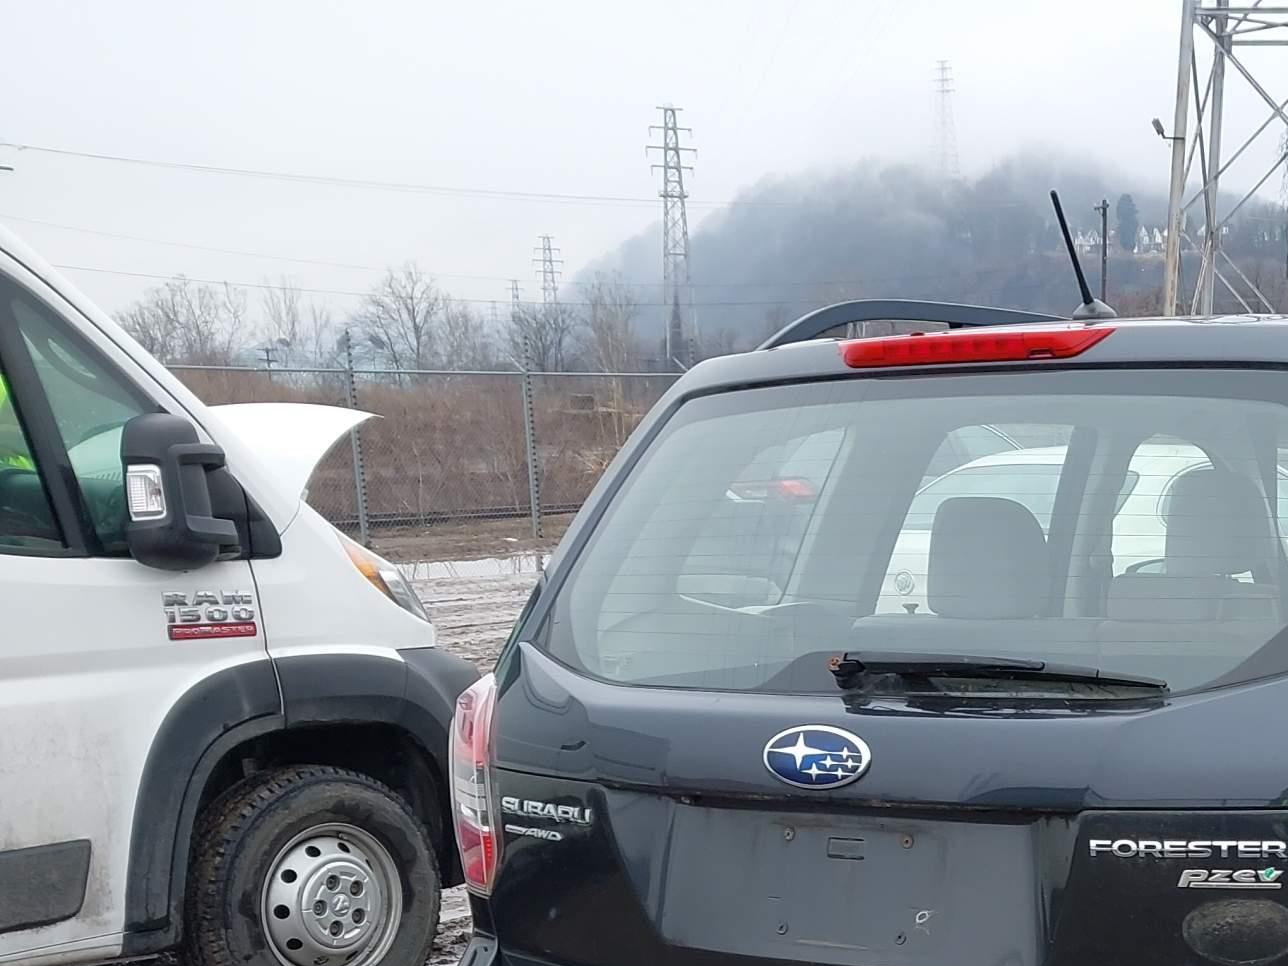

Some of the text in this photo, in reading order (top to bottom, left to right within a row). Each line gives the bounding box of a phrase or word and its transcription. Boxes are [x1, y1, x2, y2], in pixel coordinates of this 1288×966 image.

[161, 591, 252, 606] RAM
[164, 606, 254, 623] 1500
[502, 796, 592, 825] SUBARU
[525, 827, 563, 842] AWD
[1089, 839, 1288, 858] FORESTER
